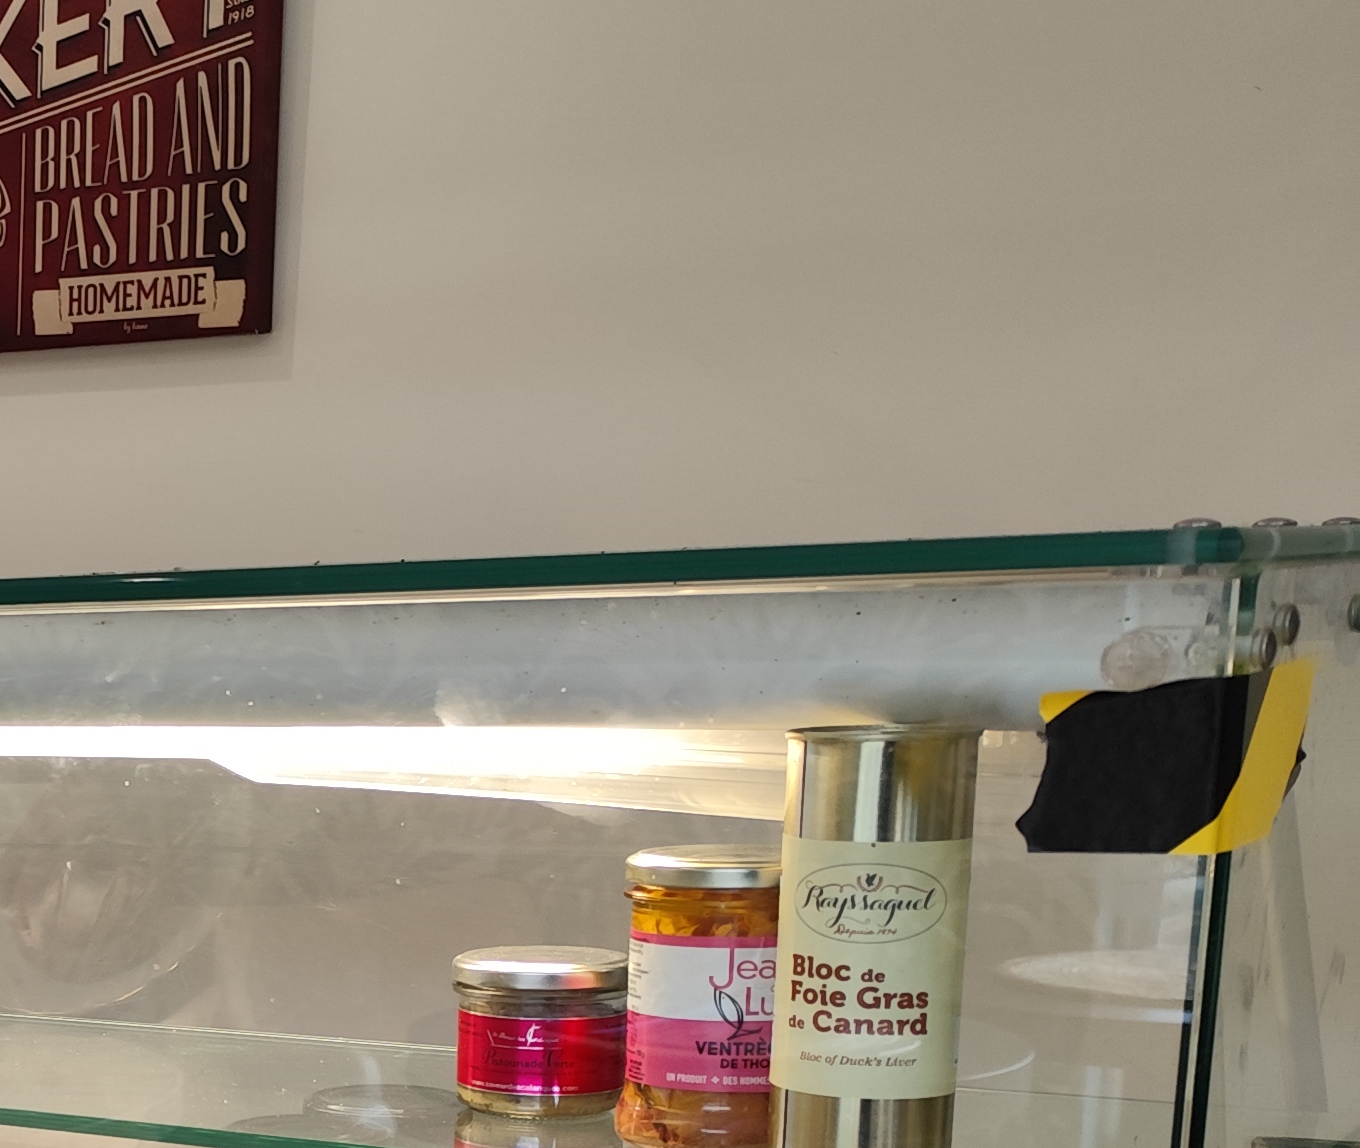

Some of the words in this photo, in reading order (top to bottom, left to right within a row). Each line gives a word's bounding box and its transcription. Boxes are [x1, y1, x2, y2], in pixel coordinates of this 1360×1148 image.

[228, 5, 255, 25] 1918
[34, 92, 154, 194] BREAD
[168, 56, 252, 177] AND
[34, 178, 248, 274] PASTRIES
[67, 272, 208, 317] HOMEMADE
[792, 953, 851, 981] Bloc
[860, 968, 885, 983] de
[791, 979, 847, 1007] Foie
[856, 986, 929, 1009] Gras
[788, 1014, 805, 1029] de
[812, 1010, 928, 1036] Canard
[695, 1037, 771, 1056] VENTRÈ
[799, 1051, 823, 1063] Bloc
[824, 1055, 838, 1066] of
[839, 1055, 882, 1067] Duck's
[885, 1056, 917, 1068] Liver
[720, 1059, 738, 1069] DE
[741, 1058, 770, 1069] THO
[739, 1075, 770, 1085] HOMME
